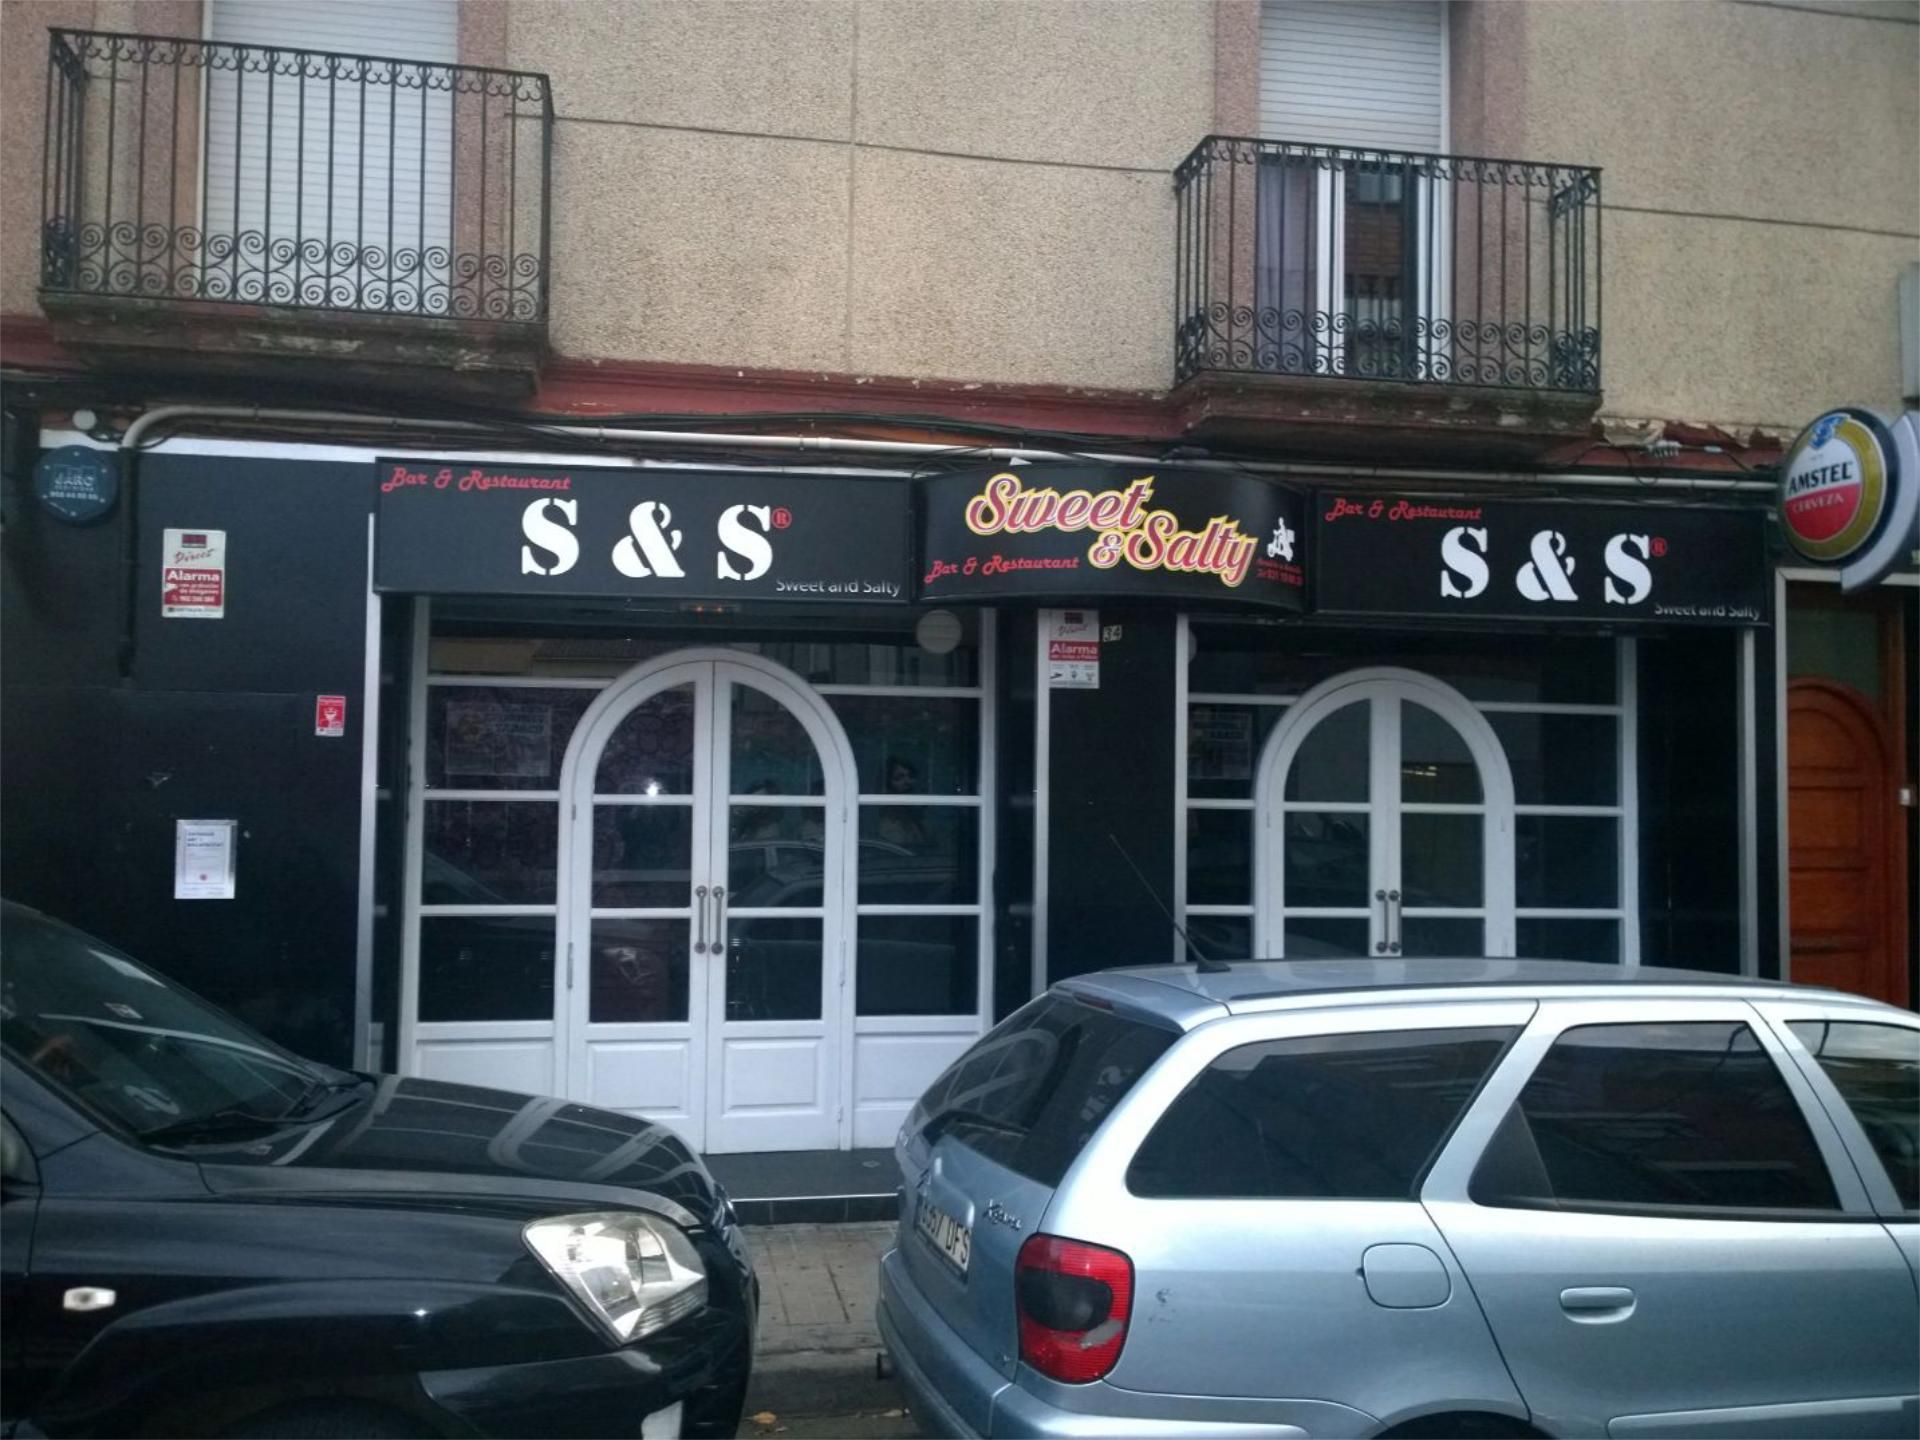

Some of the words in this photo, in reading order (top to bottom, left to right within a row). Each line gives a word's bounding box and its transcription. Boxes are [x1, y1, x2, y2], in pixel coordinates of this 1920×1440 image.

[381, 467, 428, 493] Bar
[458, 470, 572, 492] Restaurant
[1788, 461, 1853, 495] AMSTEL
[965, 473, 1155, 535] Sweet
[1325, 498, 1363, 522] Bar
[1388, 500, 1483, 521] Restaurant
[1792, 493, 1845, 514] CERVEZA
[521, 497, 580, 576] S
[612, 500, 686, 579] &
[717, 504, 773, 581] S
[1088, 529, 1124, 569] &
[1125, 510, 1258, 587] Salty
[167, 570, 220, 582] Alarma
[923, 560, 958, 584] Bar
[982, 554, 1080, 576] Restaurant
[1440, 526, 1490, 599] S
[1515, 529, 1579, 601] &
[1604, 533, 1653, 604] S
[776, 579, 825, 592] Sweet
[827, 580, 859, 593] and
[863, 579, 901, 598] Salty
[1654, 603, 1697, 616] Sweet
[1698, 605, 1726, 617] and
[1728, 604, 1761, 621] Salty
[1051, 643, 1098, 655] Alarma
